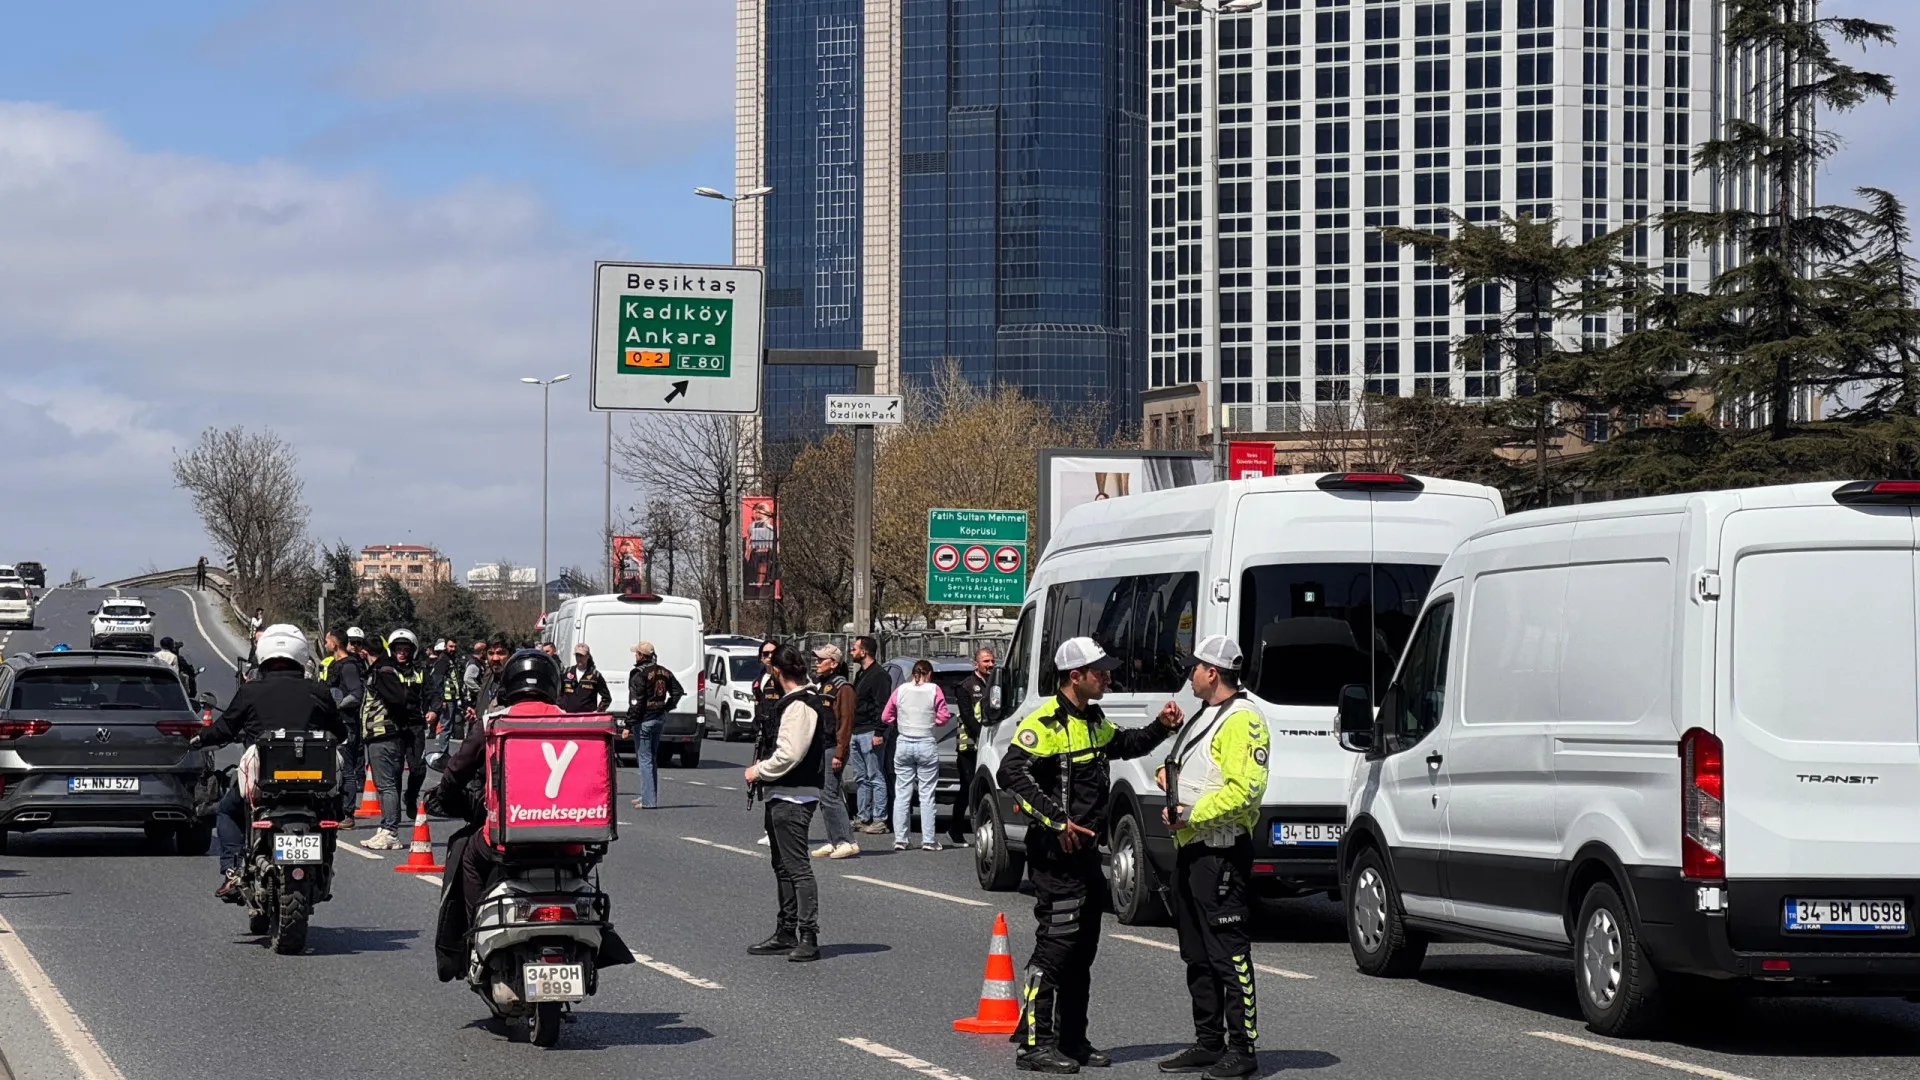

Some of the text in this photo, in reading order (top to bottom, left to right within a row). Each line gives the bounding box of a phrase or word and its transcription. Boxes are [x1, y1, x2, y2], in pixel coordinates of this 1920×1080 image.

[627, 273, 736, 294] Beşiktaş
[625, 302, 727, 326] Kadıköy
[625, 326, 716, 346] Ankara
[830, 400, 871, 410] Kanyon
[931, 511, 1026, 522] Fatih Sultan Mehmet
[960, 526, 997, 536] Köprüsü
[966, 576, 988, 584] Toplu
[990, 577, 1018, 585] Taşıma
[947, 583, 973, 591] Servis
[954, 592, 987, 600] Karavan
[75, 778, 135, 789] 34 NNJ 527
[1796, 774, 1879, 785] TRANSIT
[509, 804, 608, 823] Yemeksepeti
[1283, 825, 1298, 839] 34
[1305, 825, 1320, 840] ED
[277, 837, 319, 848] 34 MGZ
[286, 848, 309, 860] 686
[1800, 902, 1903, 923] 34 BM 0698
[542, 981, 572, 995] 899
